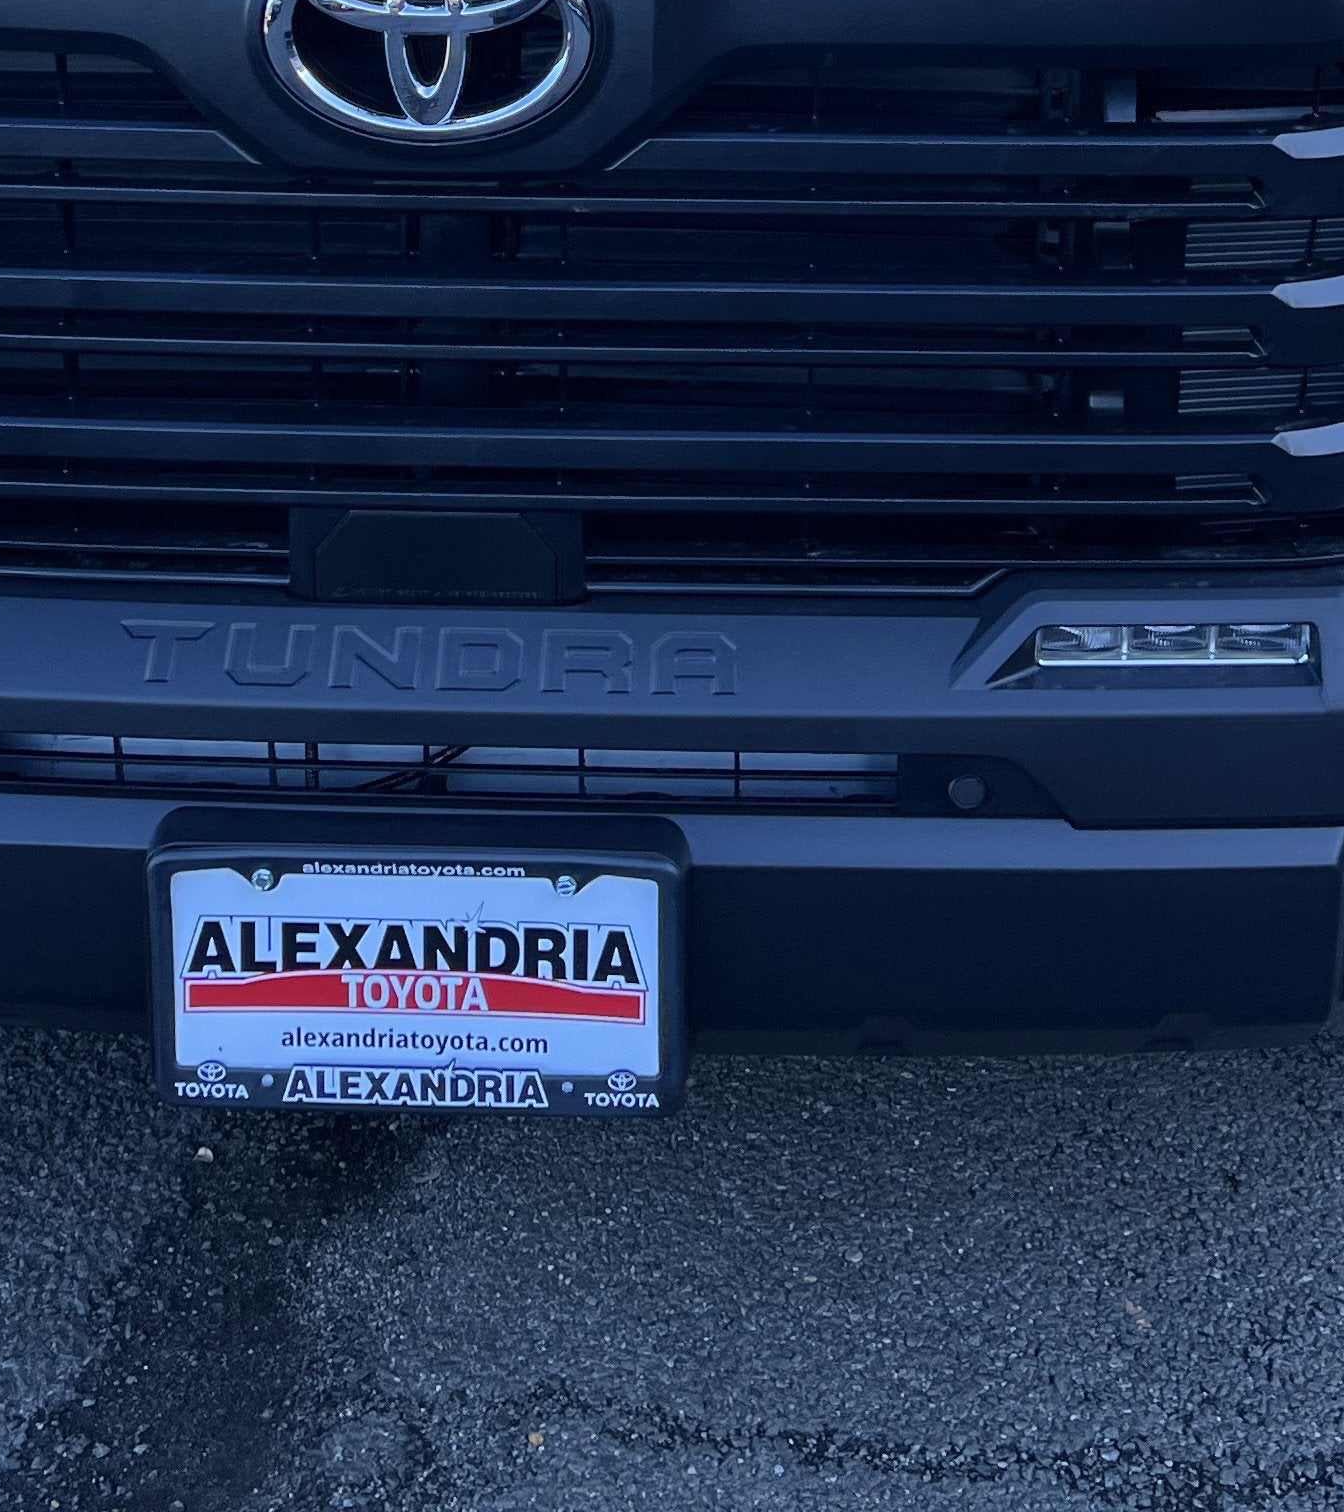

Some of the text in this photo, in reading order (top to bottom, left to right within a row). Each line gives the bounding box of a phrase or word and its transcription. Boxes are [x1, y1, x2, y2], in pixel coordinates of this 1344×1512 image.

[120, 618, 738, 696] TUNDRA
[301, 861, 526, 878] alexandriatoyota.com
[188, 919, 642, 986] ALEXANDRIA
[341, 973, 489, 1012] TOYOTA
[280, 1026, 549, 1056] alexandriatoyota.com
[174, 1080, 250, 1101] TOYOTA
[284, 1065, 549, 1108] ALEXANDRIA
[583, 1092, 660, 1108] TOYOTA
